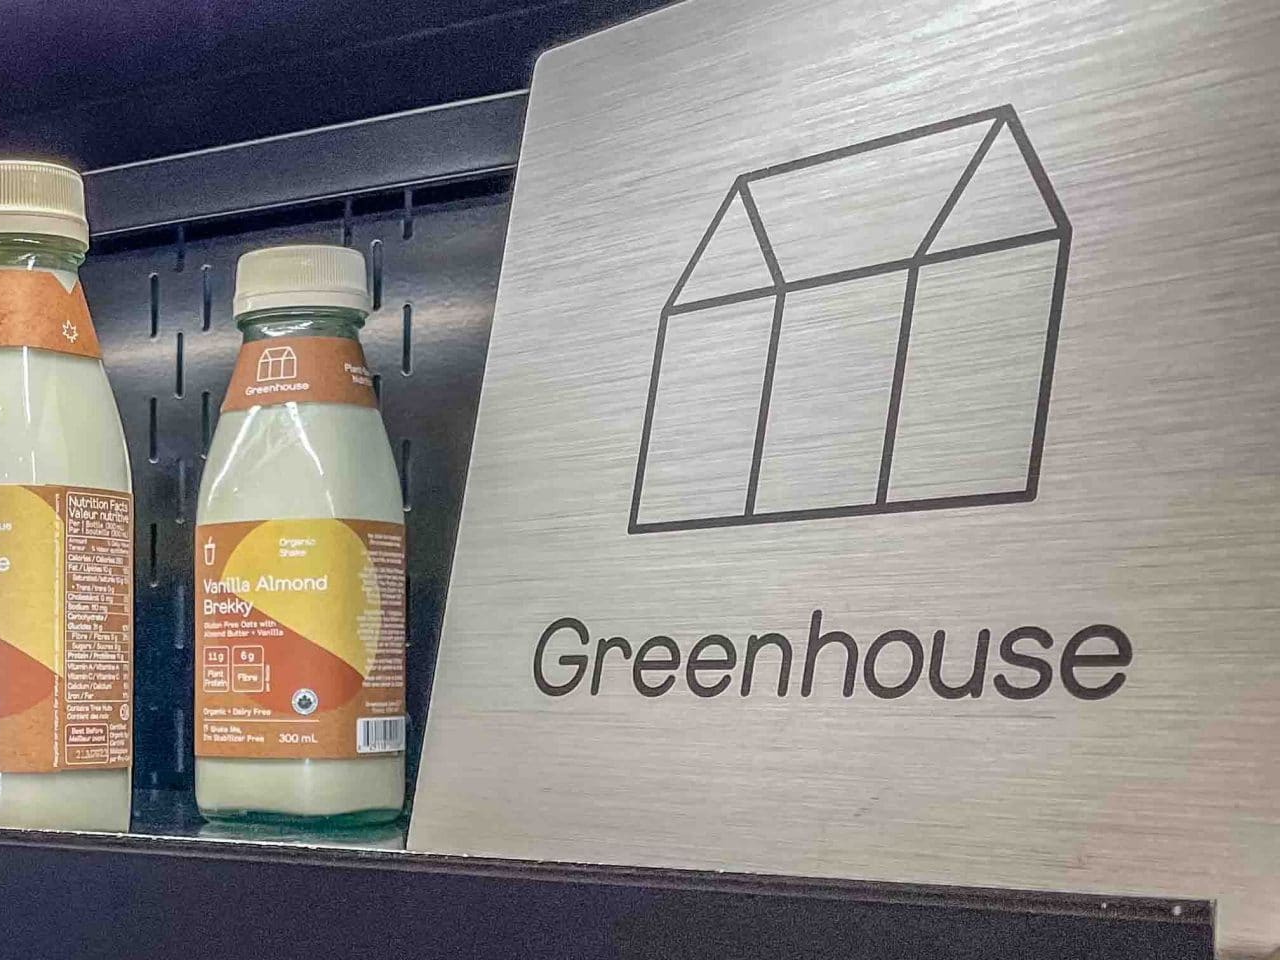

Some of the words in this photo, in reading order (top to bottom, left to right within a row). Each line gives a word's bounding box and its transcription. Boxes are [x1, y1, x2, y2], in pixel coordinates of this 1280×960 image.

[245, 382, 310, 396] Greenhouse
[68, 496, 109, 510] Nutrition
[110, 499, 128, 512] Facts
[68, 508, 97, 519] Valeur
[279, 537, 316, 548] Organic
[279, 548, 306, 557] Shake
[203, 577, 250, 594] Vanilla
[255, 574, 328, 592] Almond
[204, 598, 253, 618] Brekky
[533, 609, 1133, 700] Greenhouse
[232, 708, 252, 716] Dairy
[253, 707, 271, 716] Free
[214, 734, 245, 742] Stabilizer
[279, 733, 299, 743] 300
[301, 734, 318, 743] mL
